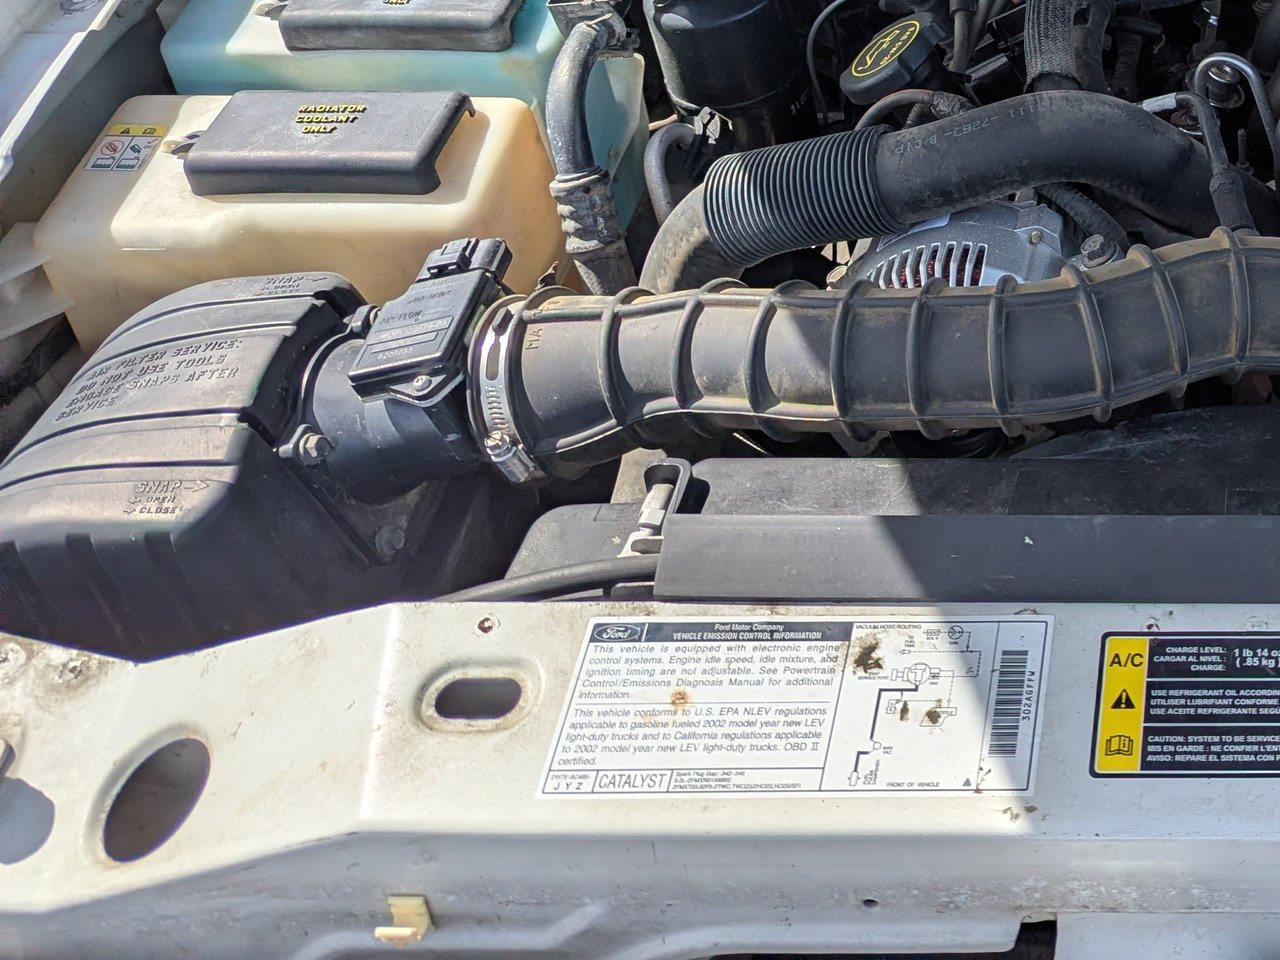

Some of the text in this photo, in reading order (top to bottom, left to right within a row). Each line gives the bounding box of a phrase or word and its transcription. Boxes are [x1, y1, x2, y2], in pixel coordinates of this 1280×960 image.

[298, 104, 367, 113] RADIATOR
[295, 115, 359, 123] COOLANT
[302, 125, 338, 134] ONLY
[87, 338, 243, 381] AIR FILTER SERVICE:
[76, 353, 228, 395] DO NOT USE TOOLS
[65, 367, 239, 409] ENGAGE SNAPS AFTER
[55, 395, 118, 421] SERVICE
[135, 480, 182, 494] SNAP
[146, 496, 176, 504] OPEN
[602, 626, 631, 639] Ford
[752, 624, 784, 632] Company
[673, 631, 822, 640] VEHICLE EMISSION CONTROL INFORMATION
[593, 644, 840, 654] This vehicle is equipped with electronic engine
[1233, 648, 1239, 656] 1
[1243, 648, 1253, 656] lb
[1257, 648, 1268, 656] 14
[589, 655, 838, 666] control systems. Engine idle speed, idle mixture, and
[1109, 652, 1144, 667] A/C
[1243, 658, 1275, 667] .85 kg
[586, 668, 620, 677] ignition
[626, 668, 655, 677] timing
[701, 666, 754, 676] adjustable.
[759, 666, 778, 675] See
[783, 666, 836, 675] Powertrain
[676, 678, 723, 688] Diagnosis
[728, 678, 764, 687] Manual
[768, 677, 781, 686] for
[786, 677, 833, 686] additional
[579, 690, 630, 699] information.
[574, 707, 827, 717] This vehicle conforms to U.S. EPA NLEV regulations
[569, 720, 616, 730] applicable
[619, 720, 628, 728] to
[630, 720, 668, 730] gasoline
[672, 719, 700, 728] fueled
[702, 720, 727, 728] 2002
[729, 719, 757, 727] model
[759, 720, 780, 729] year
[805, 718, 826, 727] LEV
[554, 782, 583, 790] J Y Z
[598, 773, 667, 789] CATALYST
